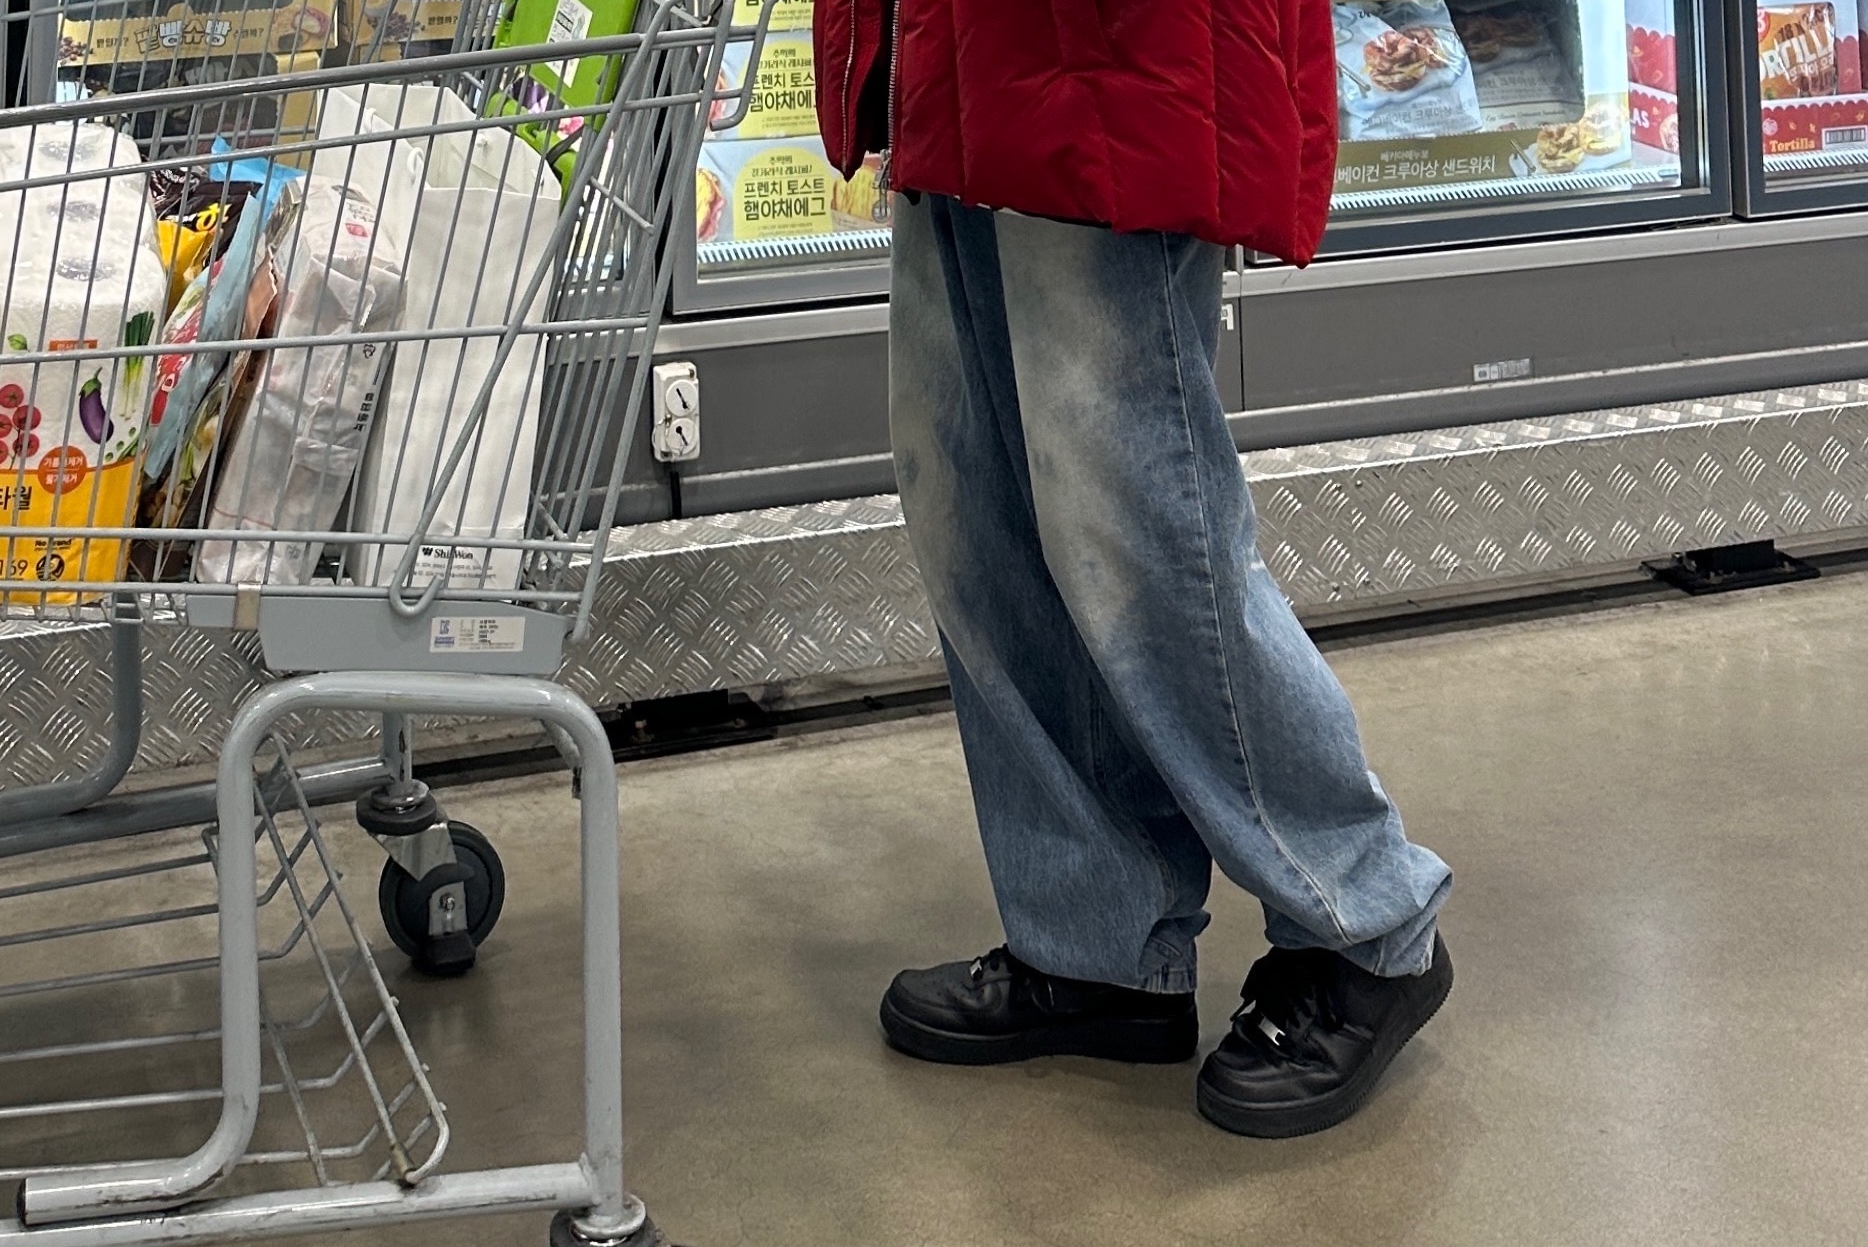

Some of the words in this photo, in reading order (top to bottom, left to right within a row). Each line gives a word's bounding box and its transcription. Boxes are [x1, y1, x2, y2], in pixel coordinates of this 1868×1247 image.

[790, 71, 815, 88] 토스
[750, 90, 816, 113] 햄야채에
[1770, 137, 1816, 153] Tortilla
[1336, 165, 1380, 183] 베이컨
[1383, 161, 1439, 181] 크루아상
[1441, 156, 1496, 176] 샌드위치
[744, 180, 783, 198] 프렌치
[786, 178, 826, 196] 토스트
[743, 196, 826, 221] 햄야채에그
[48, 538, 73, 547] rand
[434, 548, 474, 560] ShiWon
